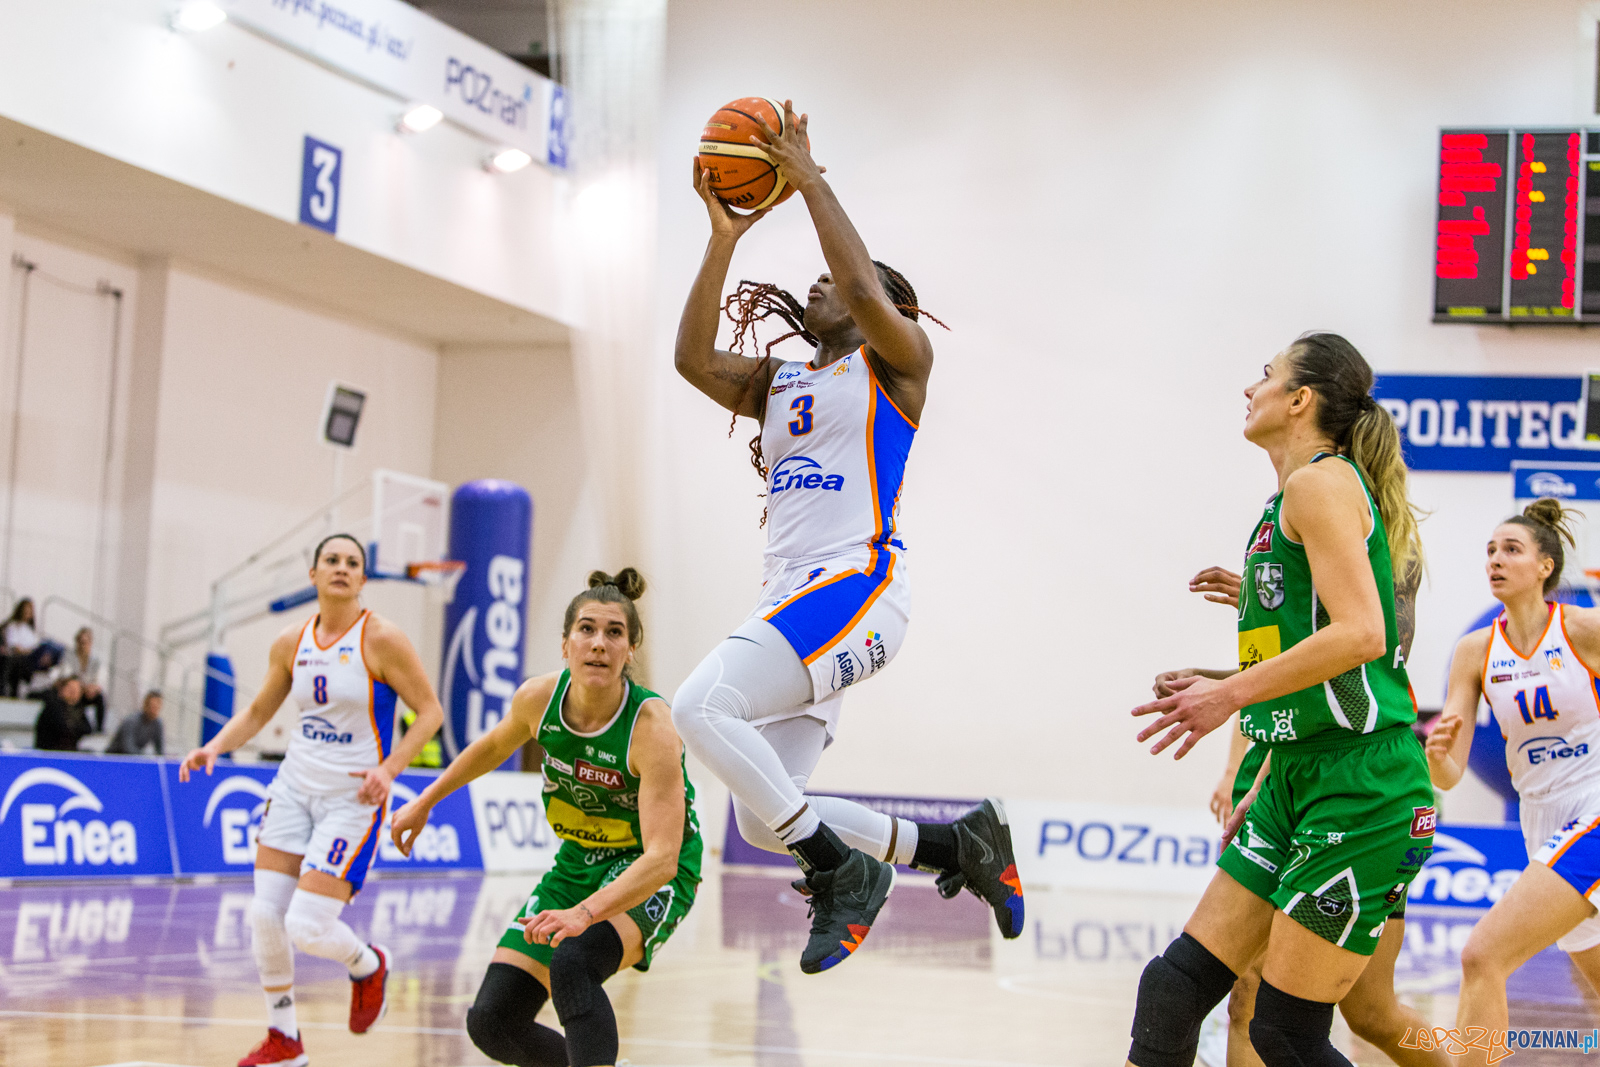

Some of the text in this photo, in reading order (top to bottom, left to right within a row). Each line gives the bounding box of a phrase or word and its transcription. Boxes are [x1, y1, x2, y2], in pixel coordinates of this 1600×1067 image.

[309, 145, 338, 223] 3
[787, 394, 815, 437] 3
[770, 469, 845, 495] Enea
[464, 554, 525, 744] Enea
[313, 675, 329, 706] 8
[1513, 684, 1559, 725] 14
[303, 723, 353, 743] Enea
[578, 766, 620, 786] PERŁA
[597, 750, 617, 764] UMCS
[20, 802, 138, 866] Enea
[484, 799, 550, 849] POZ
[1038, 819, 1221, 868] POZna
[326, 837, 349, 867] 8
[1407, 865, 1526, 904] nea
